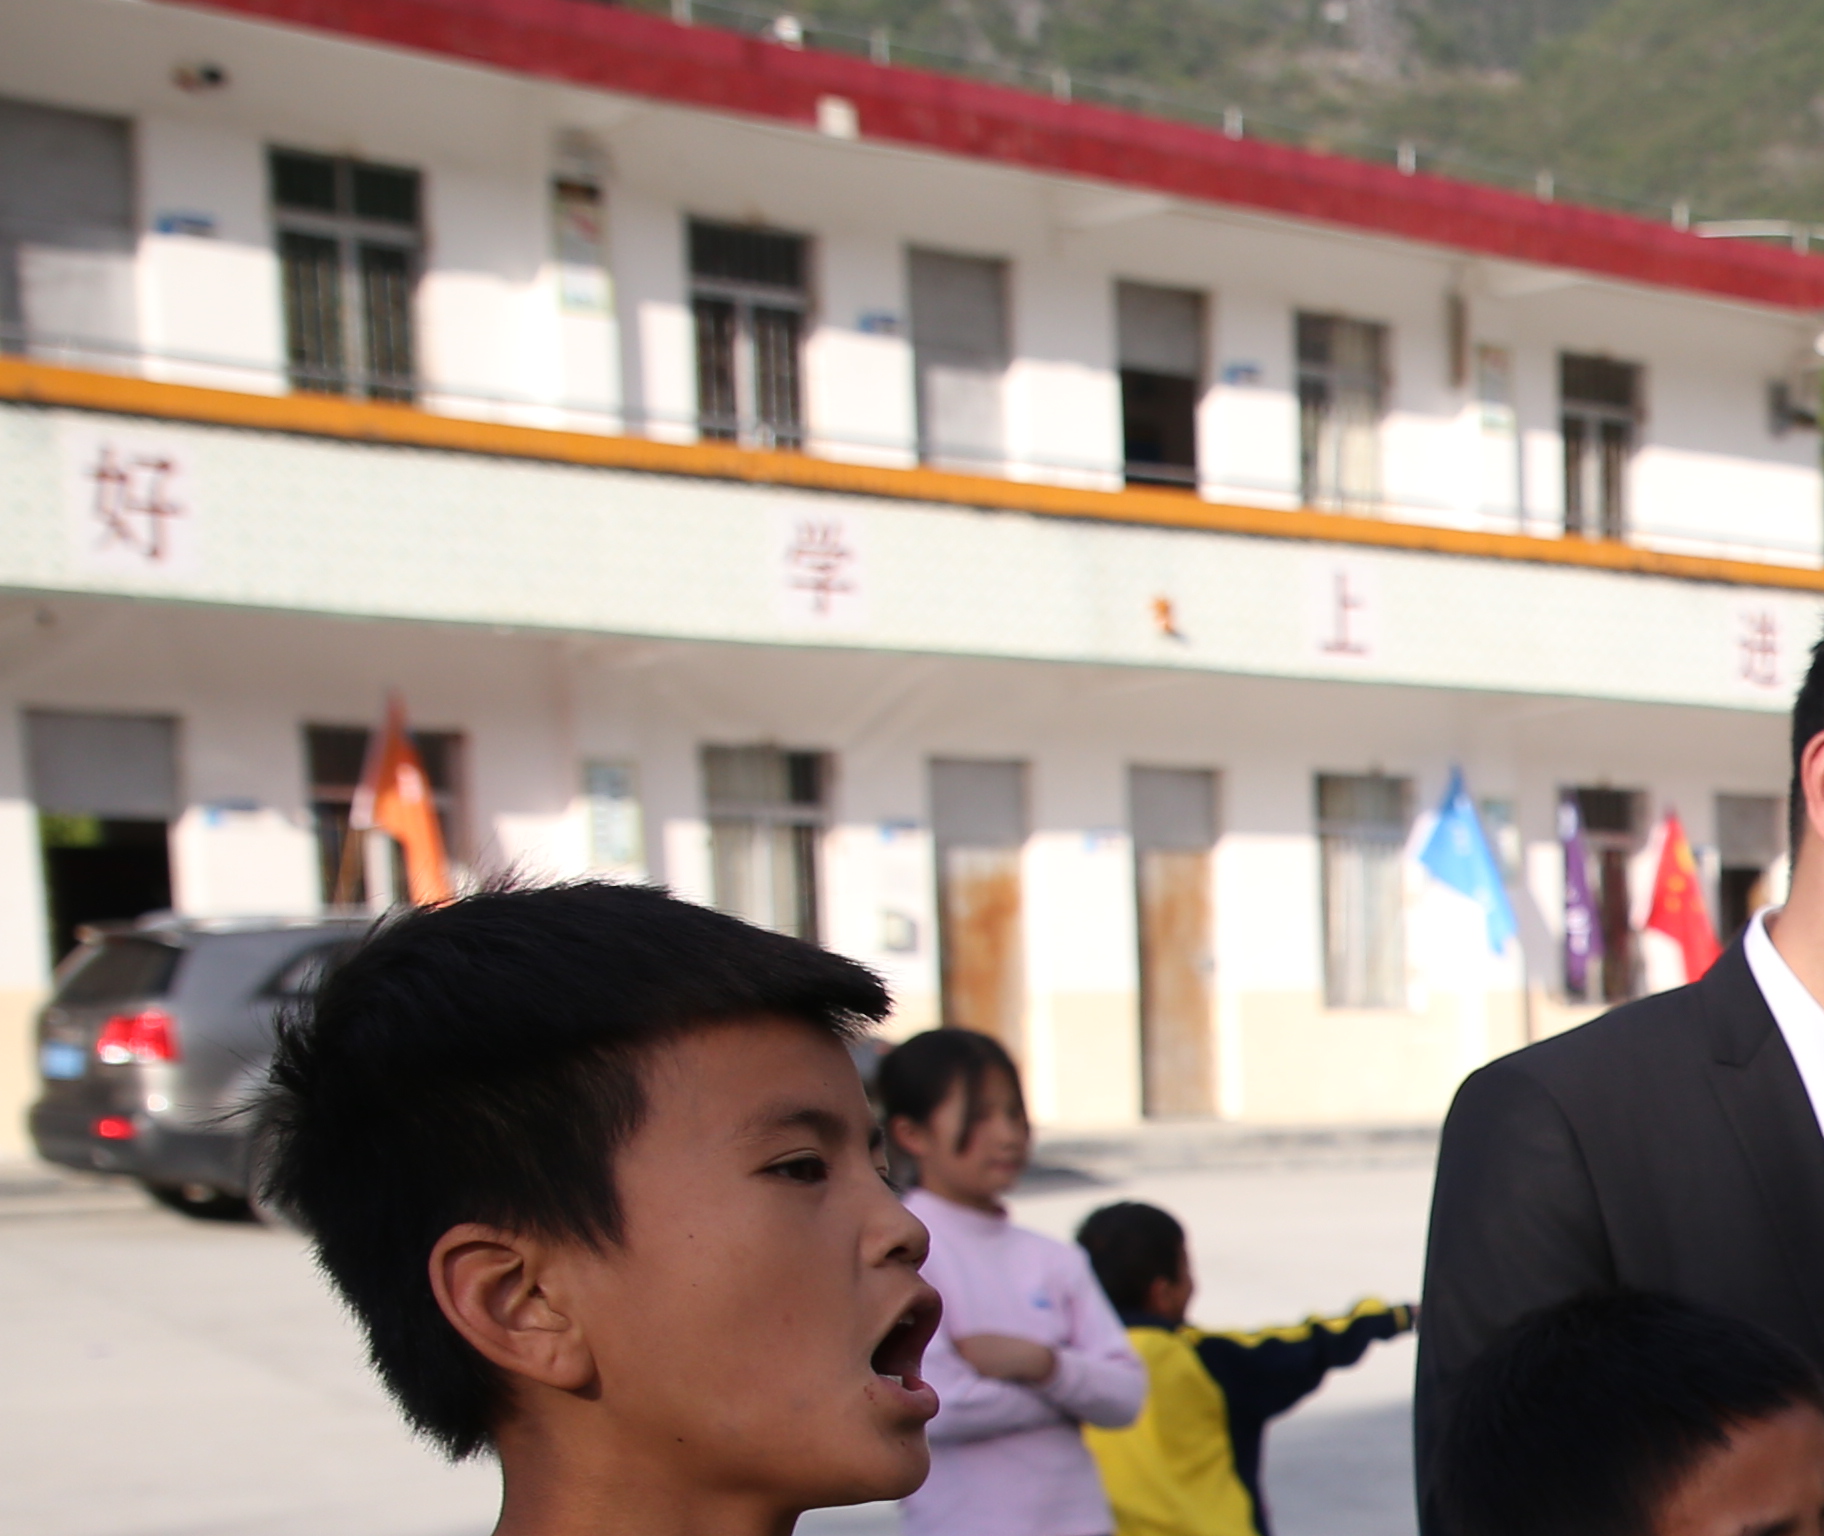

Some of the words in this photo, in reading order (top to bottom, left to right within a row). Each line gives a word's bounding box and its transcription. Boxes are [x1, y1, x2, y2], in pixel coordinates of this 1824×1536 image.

[82, 442, 188, 562] 好
[784, 518, 860, 616] 学
[1316, 568, 1375, 657] 上
